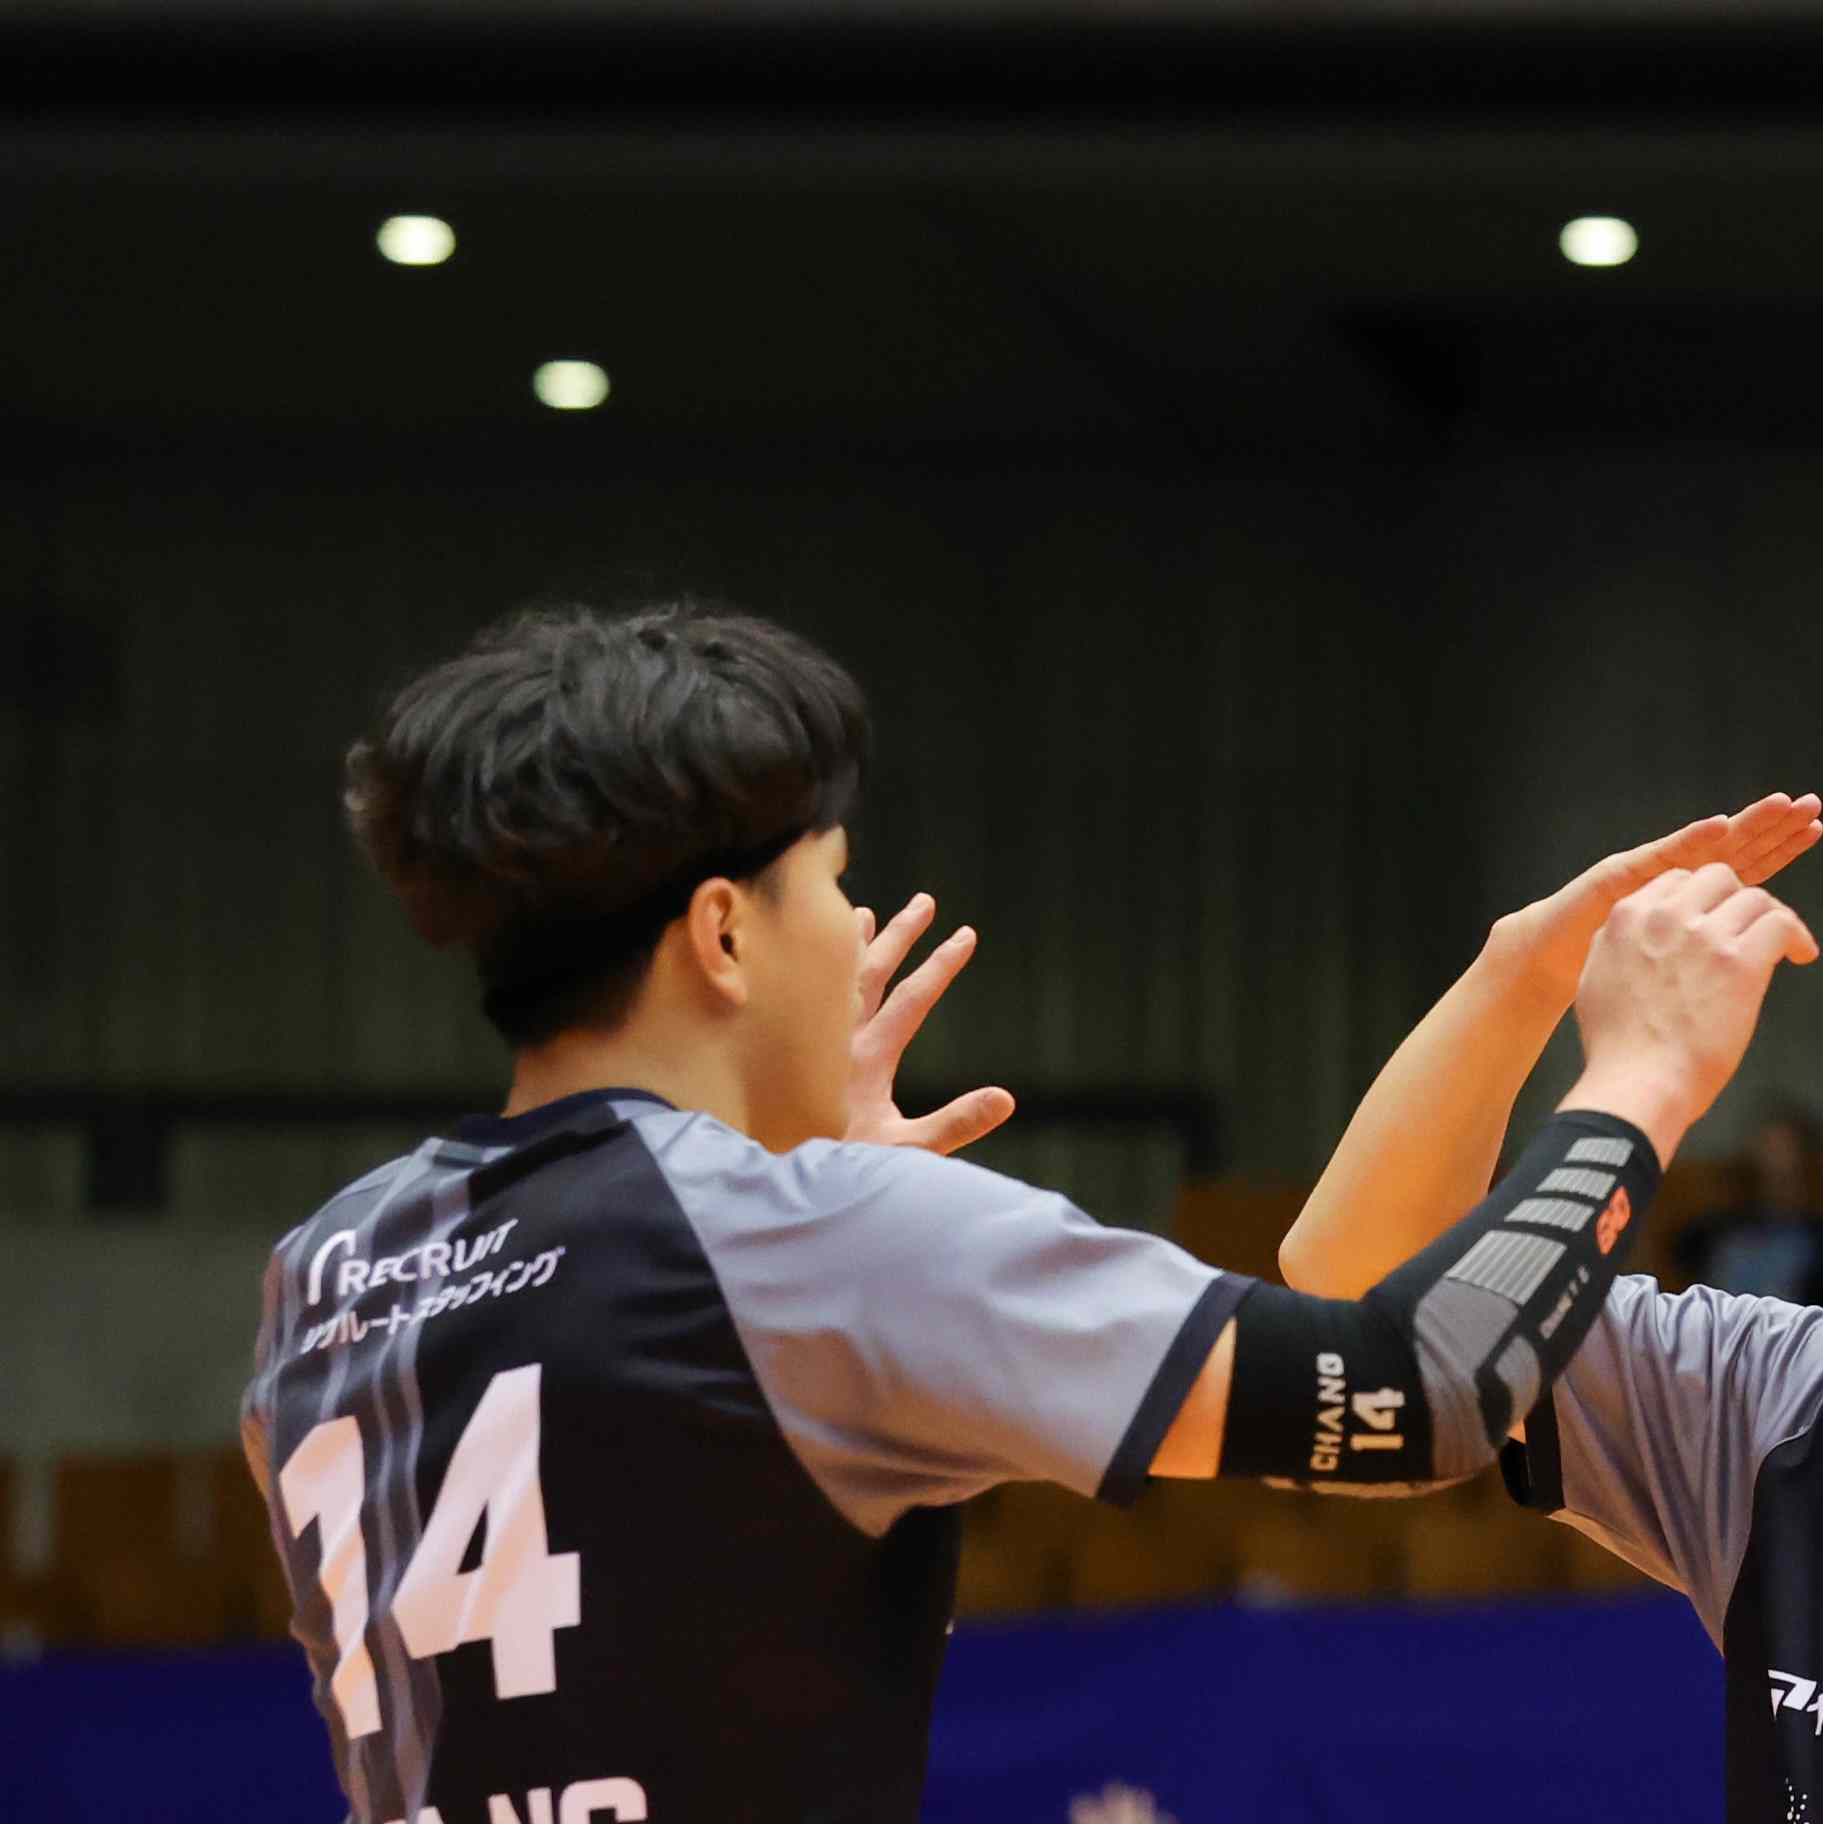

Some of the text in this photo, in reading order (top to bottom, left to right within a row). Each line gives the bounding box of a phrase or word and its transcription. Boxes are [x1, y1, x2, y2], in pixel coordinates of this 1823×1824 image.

[337, 1218, 518, 1296] RECRUIT
[1351, 1387, 1406, 1451] 14
[279, 1362, 582, 1740] 14
